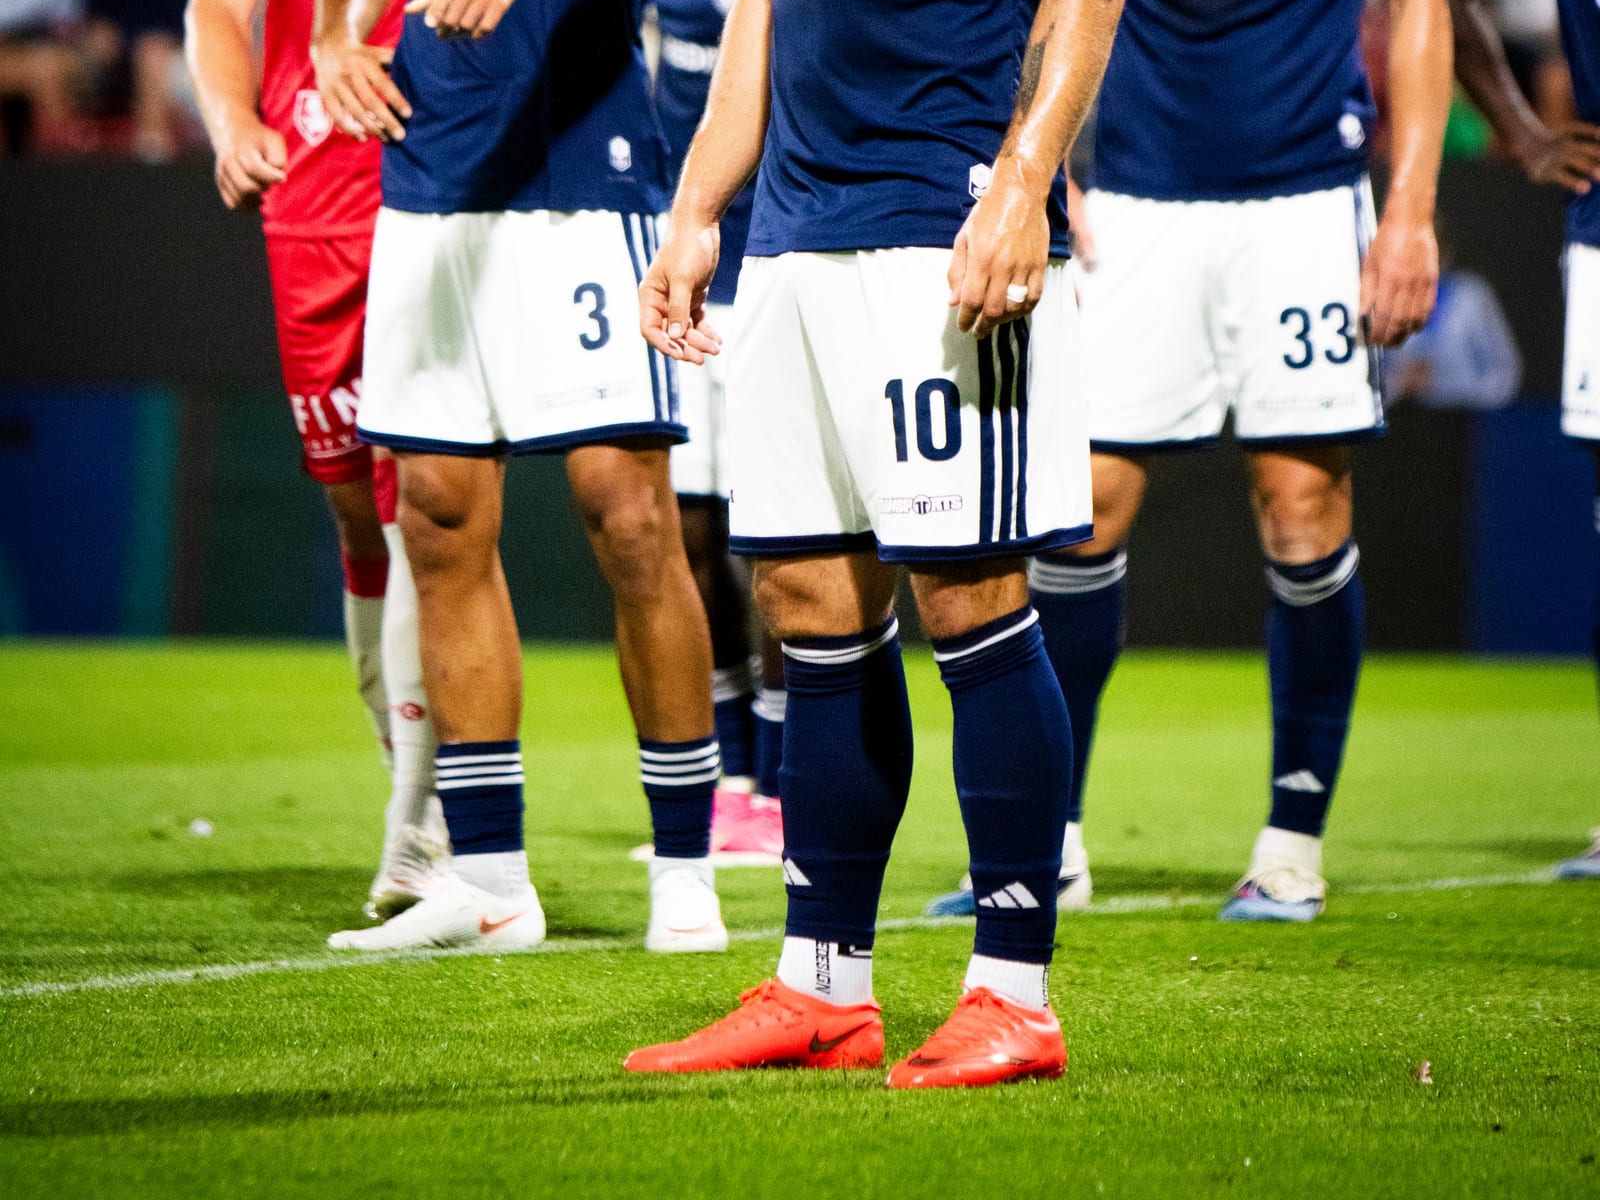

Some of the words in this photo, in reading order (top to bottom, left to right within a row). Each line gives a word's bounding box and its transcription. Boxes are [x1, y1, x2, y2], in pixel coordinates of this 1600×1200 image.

[573, 282, 610, 351] 3
[1279, 302, 1355, 369] 33
[885, 378, 962, 462] 10
